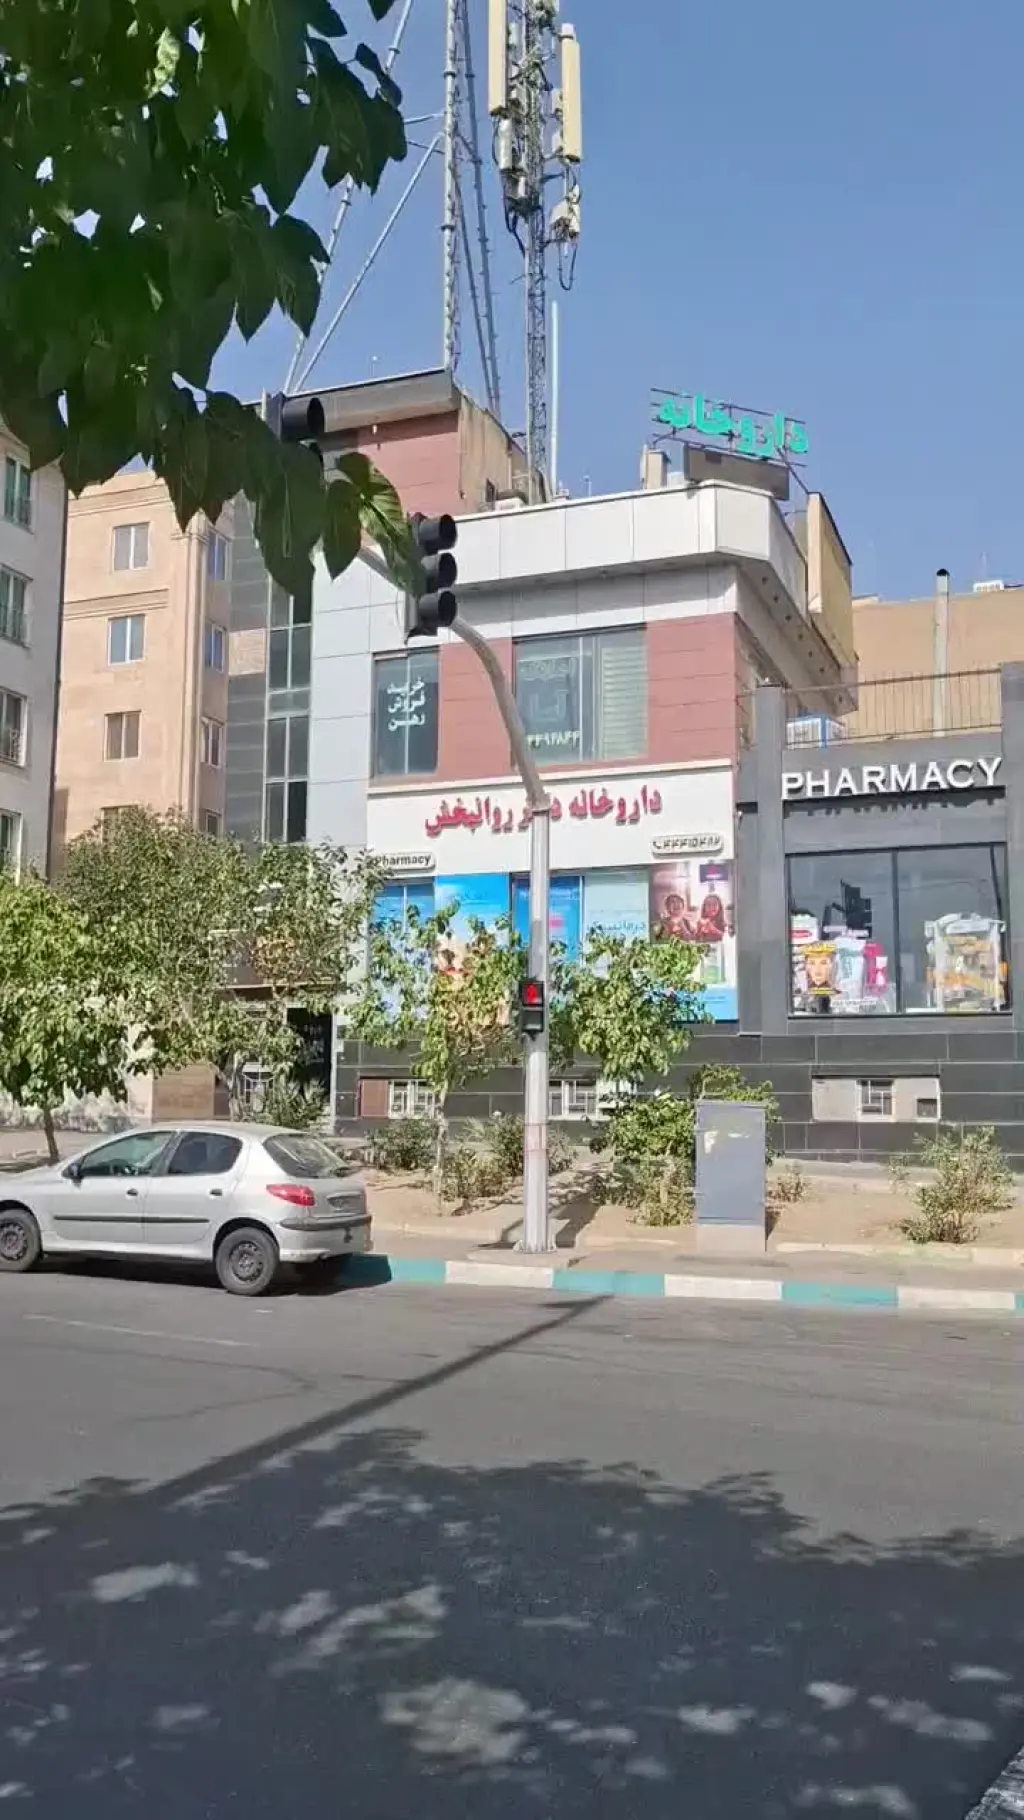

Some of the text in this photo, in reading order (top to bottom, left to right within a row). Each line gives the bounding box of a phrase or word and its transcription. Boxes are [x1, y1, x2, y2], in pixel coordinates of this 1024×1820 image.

[659, 391, 808, 457] داروخانه
[387, 677, 425, 695] خرید
[387, 691, 425, 713] فروش
[387, 714, 425, 731] رهن
[781, 757, 1002, 800] PHARMACY
[568, 784, 662, 826] داروخانه
